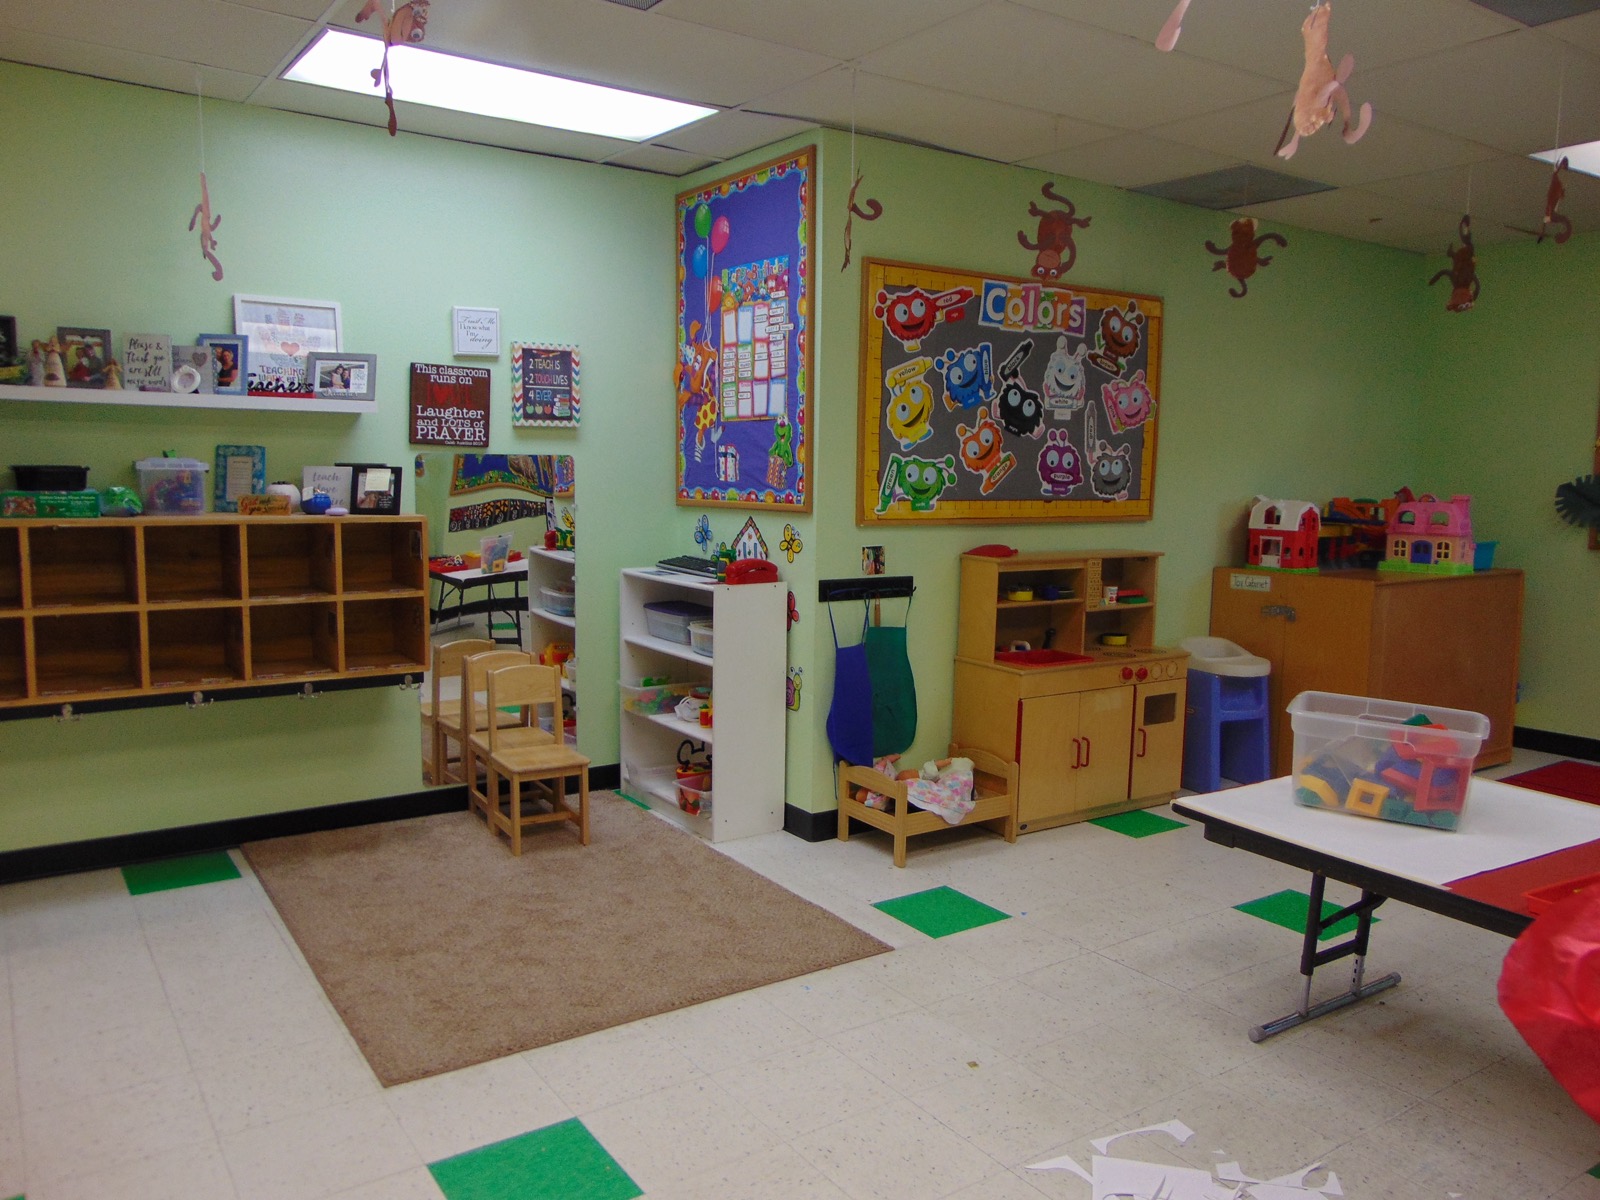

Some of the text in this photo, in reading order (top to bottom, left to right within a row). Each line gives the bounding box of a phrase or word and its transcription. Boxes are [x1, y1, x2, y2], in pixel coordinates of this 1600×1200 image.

[943, 296, 953, 304] red
[985, 287, 1083, 328] Colors
[128, 337, 153, 351] Please
[470, 333, 493, 349] doing
[126, 351, 149, 364] Thank
[1007, 356, 1021, 371] black
[415, 363, 488, 377] This classroom
[529, 358, 561, 370] 2 TEACH IS
[1099, 359, 1115, 370] brown
[144, 364, 162, 378] still
[259, 365, 305, 377] TEACHING
[898, 366, 916, 377] yellow
[430, 374, 473, 385] runs on
[535, 373, 552, 384] TOUCH
[552, 374, 569, 385] LIVES
[528, 389, 552, 401] 4 EVER
[416, 405, 485, 419] Laughter
[417, 418, 485, 428] and LOTS of
[416, 425, 487, 441] PRAYER
[312, 471, 339, 482] teach
[992, 462, 1009, 480] orange
[1053, 473, 1071, 481] purple
[886, 468, 896, 490] green
